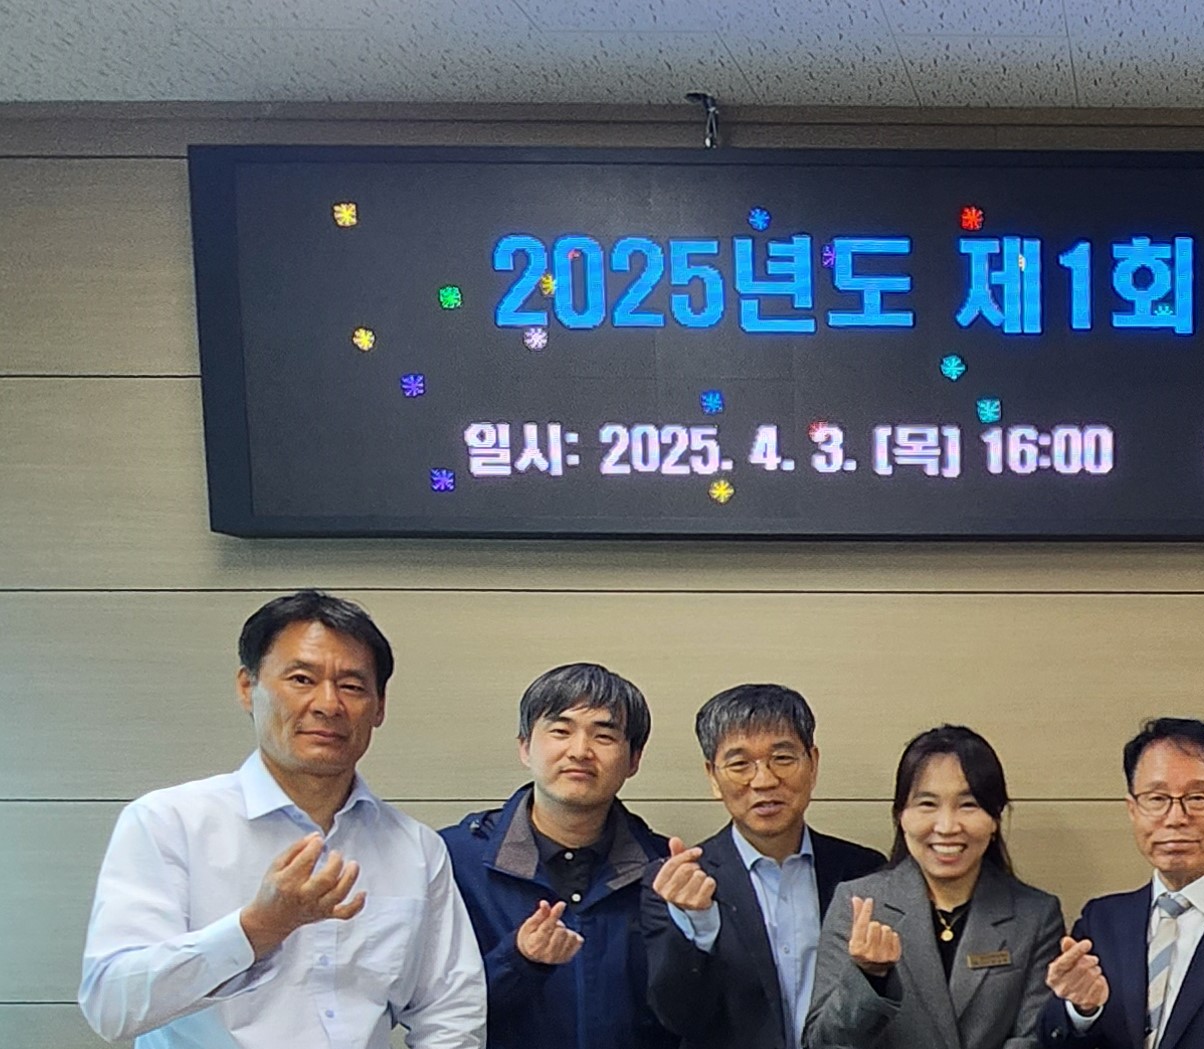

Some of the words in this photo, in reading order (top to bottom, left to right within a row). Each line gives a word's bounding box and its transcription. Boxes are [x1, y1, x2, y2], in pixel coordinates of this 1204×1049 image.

[493, 234, 915, 333] 2025년도
[957, 235, 1194, 334] 제1회
[464, 422, 579, 477] 일시:
[600, 424, 733, 475] 2025.
[749, 424, 795, 474] 4.
[811, 424, 857, 474] 3.
[981, 424, 1114, 475] 16:00
